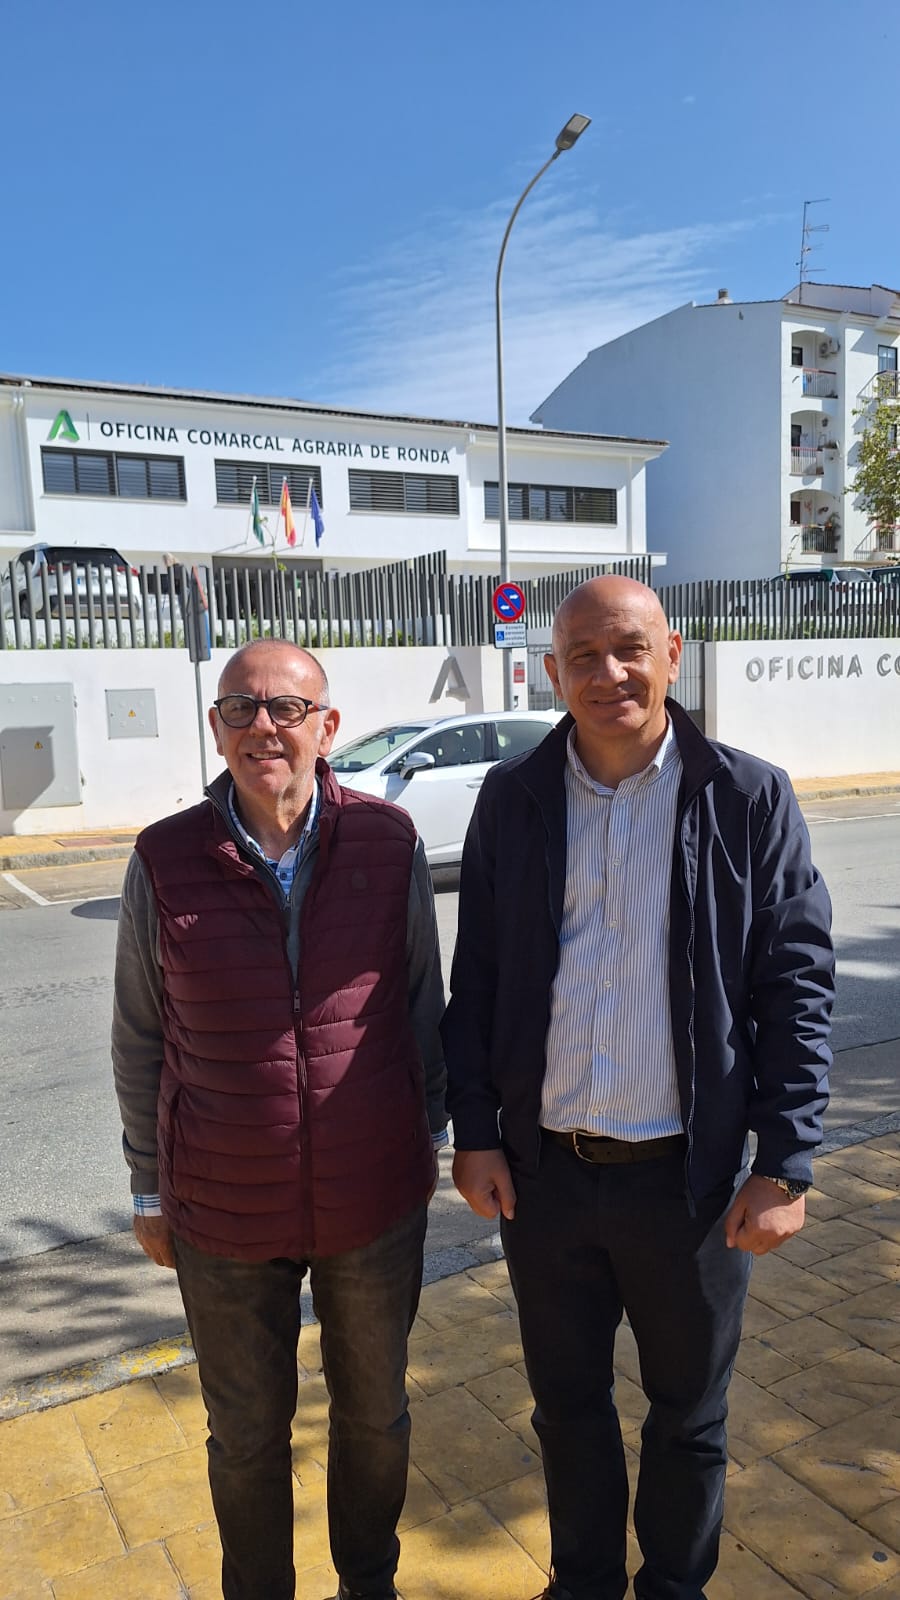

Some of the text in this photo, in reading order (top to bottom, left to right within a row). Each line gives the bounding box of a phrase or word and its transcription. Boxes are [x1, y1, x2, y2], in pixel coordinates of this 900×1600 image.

[100, 421, 450, 464] OFICINA COMARCAL AGRARIA DE RONDA
[746, 654, 863, 682] OFICINA
